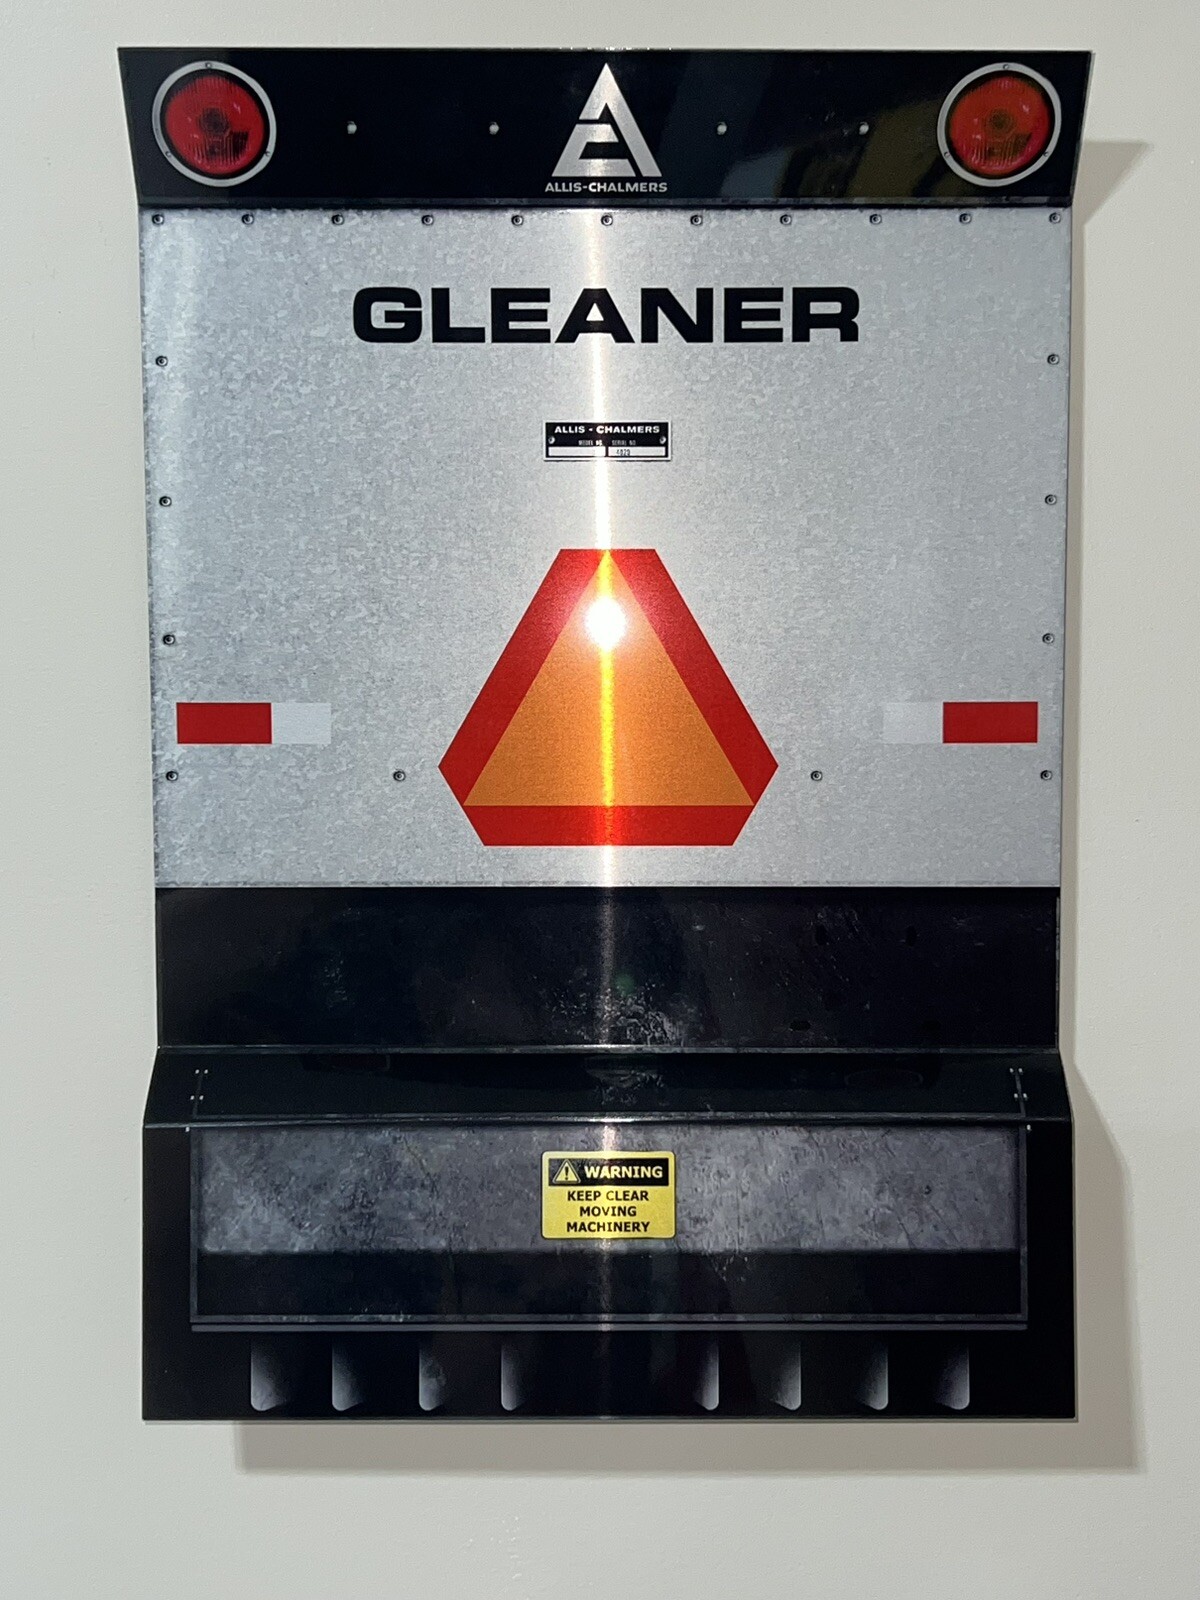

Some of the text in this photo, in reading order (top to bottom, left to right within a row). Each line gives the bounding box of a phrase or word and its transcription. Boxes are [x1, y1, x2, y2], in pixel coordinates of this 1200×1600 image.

[544, 182, 668, 193] ALLIS-CHALMERS
[352, 286, 860, 344] GLEANER
[554, 425, 586, 434] ALLIS
[595, 425, 660, 434] CHALMERS
[583, 1165, 663, 1179] WARNING
[567, 1190, 650, 1201] KEEP CLEAR
[579, 1205, 637, 1217] MOVING
[566, 1221, 651, 1233] MACHINERY
